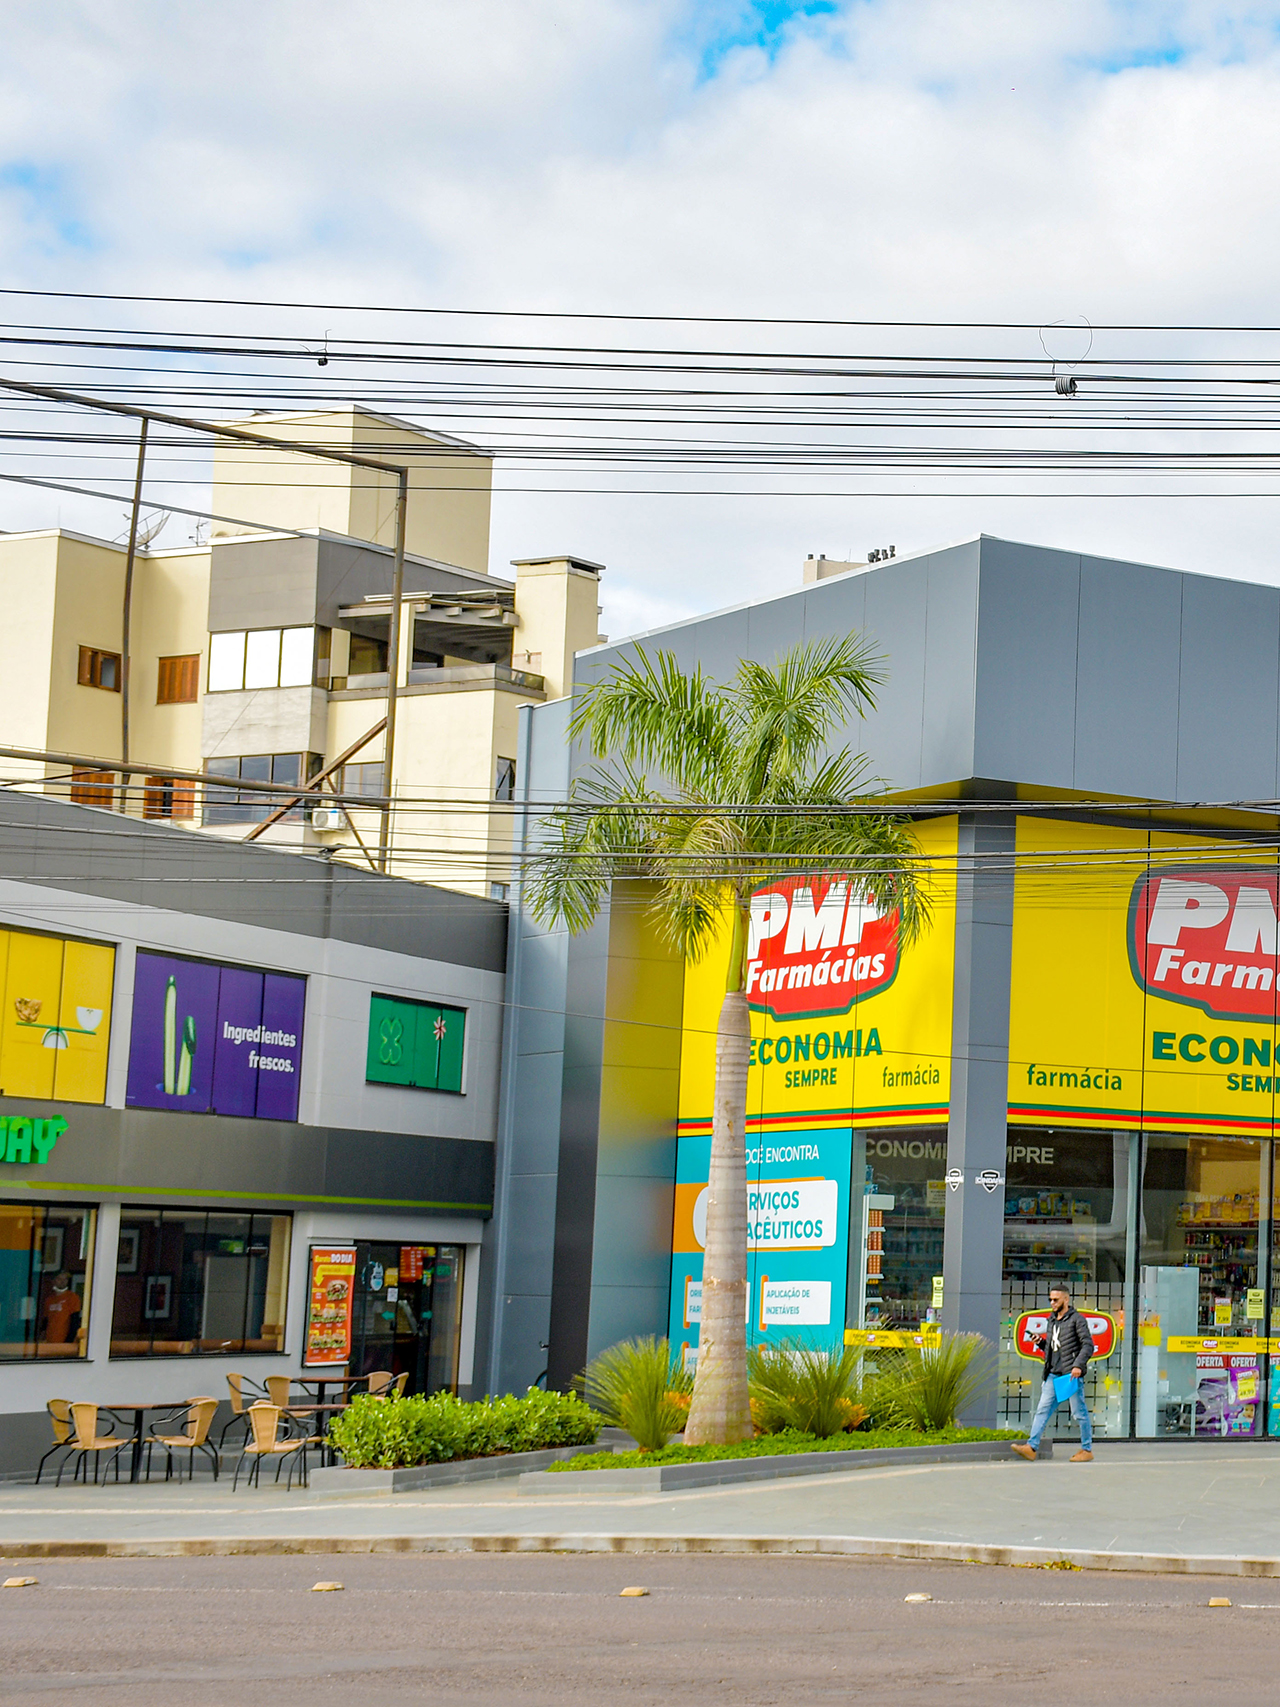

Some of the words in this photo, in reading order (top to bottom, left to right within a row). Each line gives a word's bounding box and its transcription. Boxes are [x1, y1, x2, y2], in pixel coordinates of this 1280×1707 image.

[747, 879, 888, 960] PMP
[747, 948, 886, 995] Farmácias
[223, 1020, 297, 1049] Ingredientes
[248, 1051, 295, 1074] frescos.
[785, 1067, 838, 1089] SEMPRE
[882, 1064, 941, 1088] farmácia
[1027, 1064, 1123, 1091] farmácia
[745, 1144, 763, 1165] OCÊ
[765, 1144, 820, 1164] ENCONTRA
[866, 1138, 949, 1159] CONOMI
[748, 1190, 800, 1216] RVIÇOS
[747, 1216, 823, 1240] ACÊUTICOS
[766, 1287, 800, 1300] APLICAÇÃO
[802, 1289, 810, 1298] DE
[766, 1304, 800, 1315] INJETÁVEIS
[1196, 1356, 1224, 1367] OFERTA
